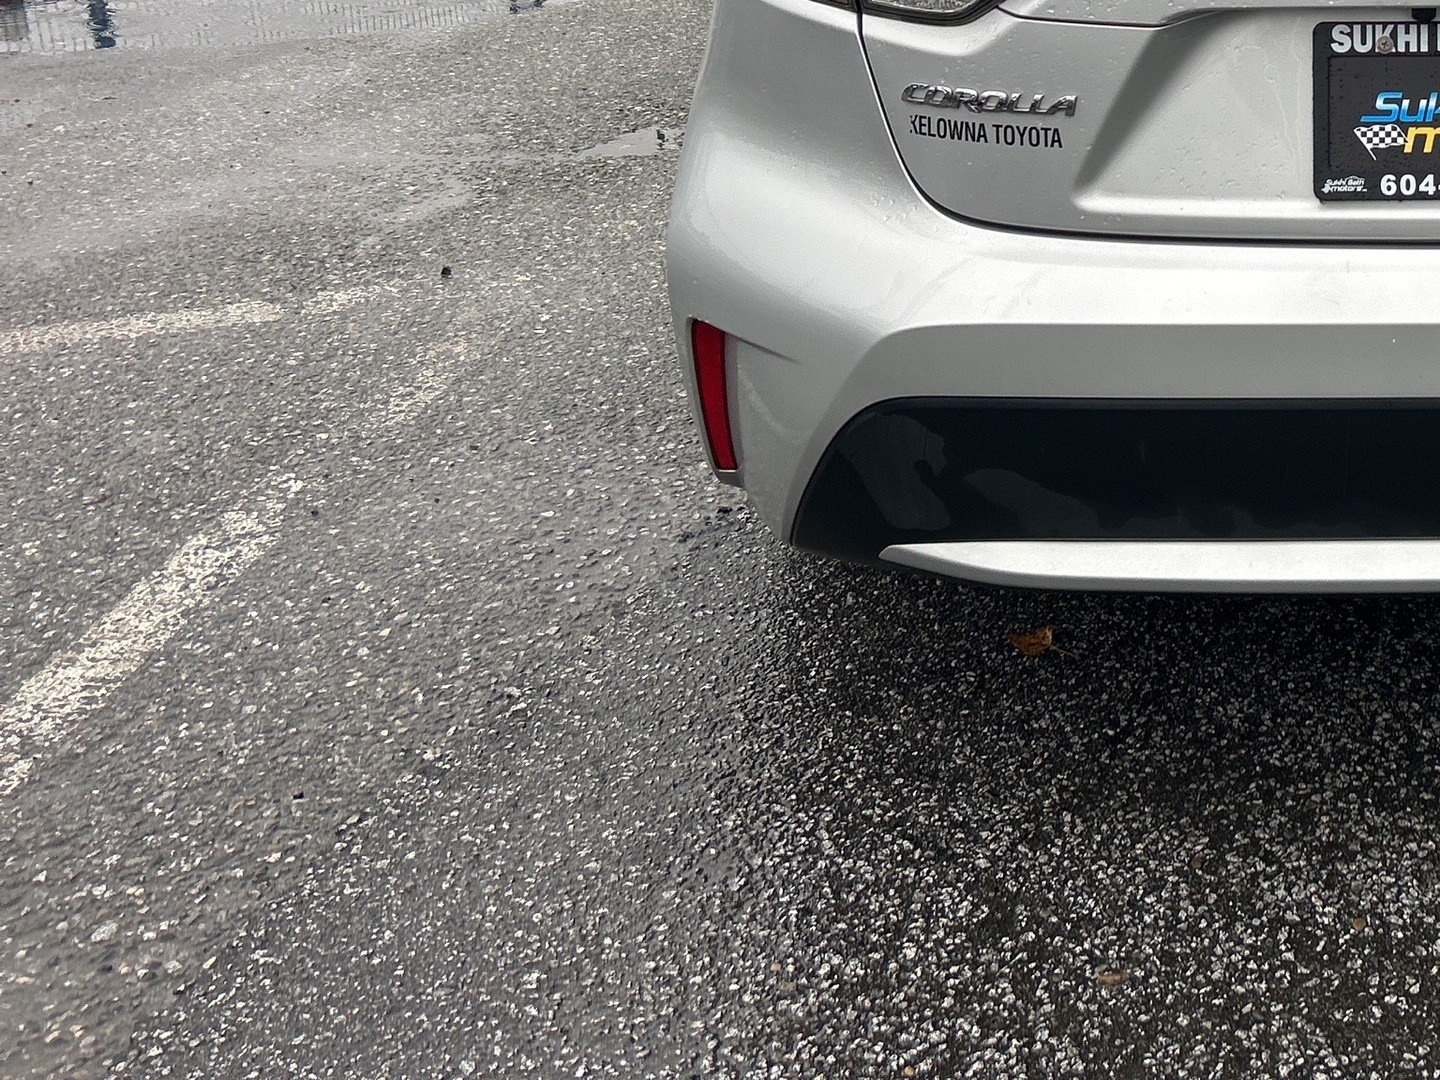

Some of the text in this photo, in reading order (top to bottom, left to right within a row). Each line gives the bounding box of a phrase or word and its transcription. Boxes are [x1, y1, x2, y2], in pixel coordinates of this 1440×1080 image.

[1331, 23, 1429, 53] SUKHI
[901, 82, 1078, 117] COROLLA
[910, 114, 1063, 148] KELOWNA TOYOTA
